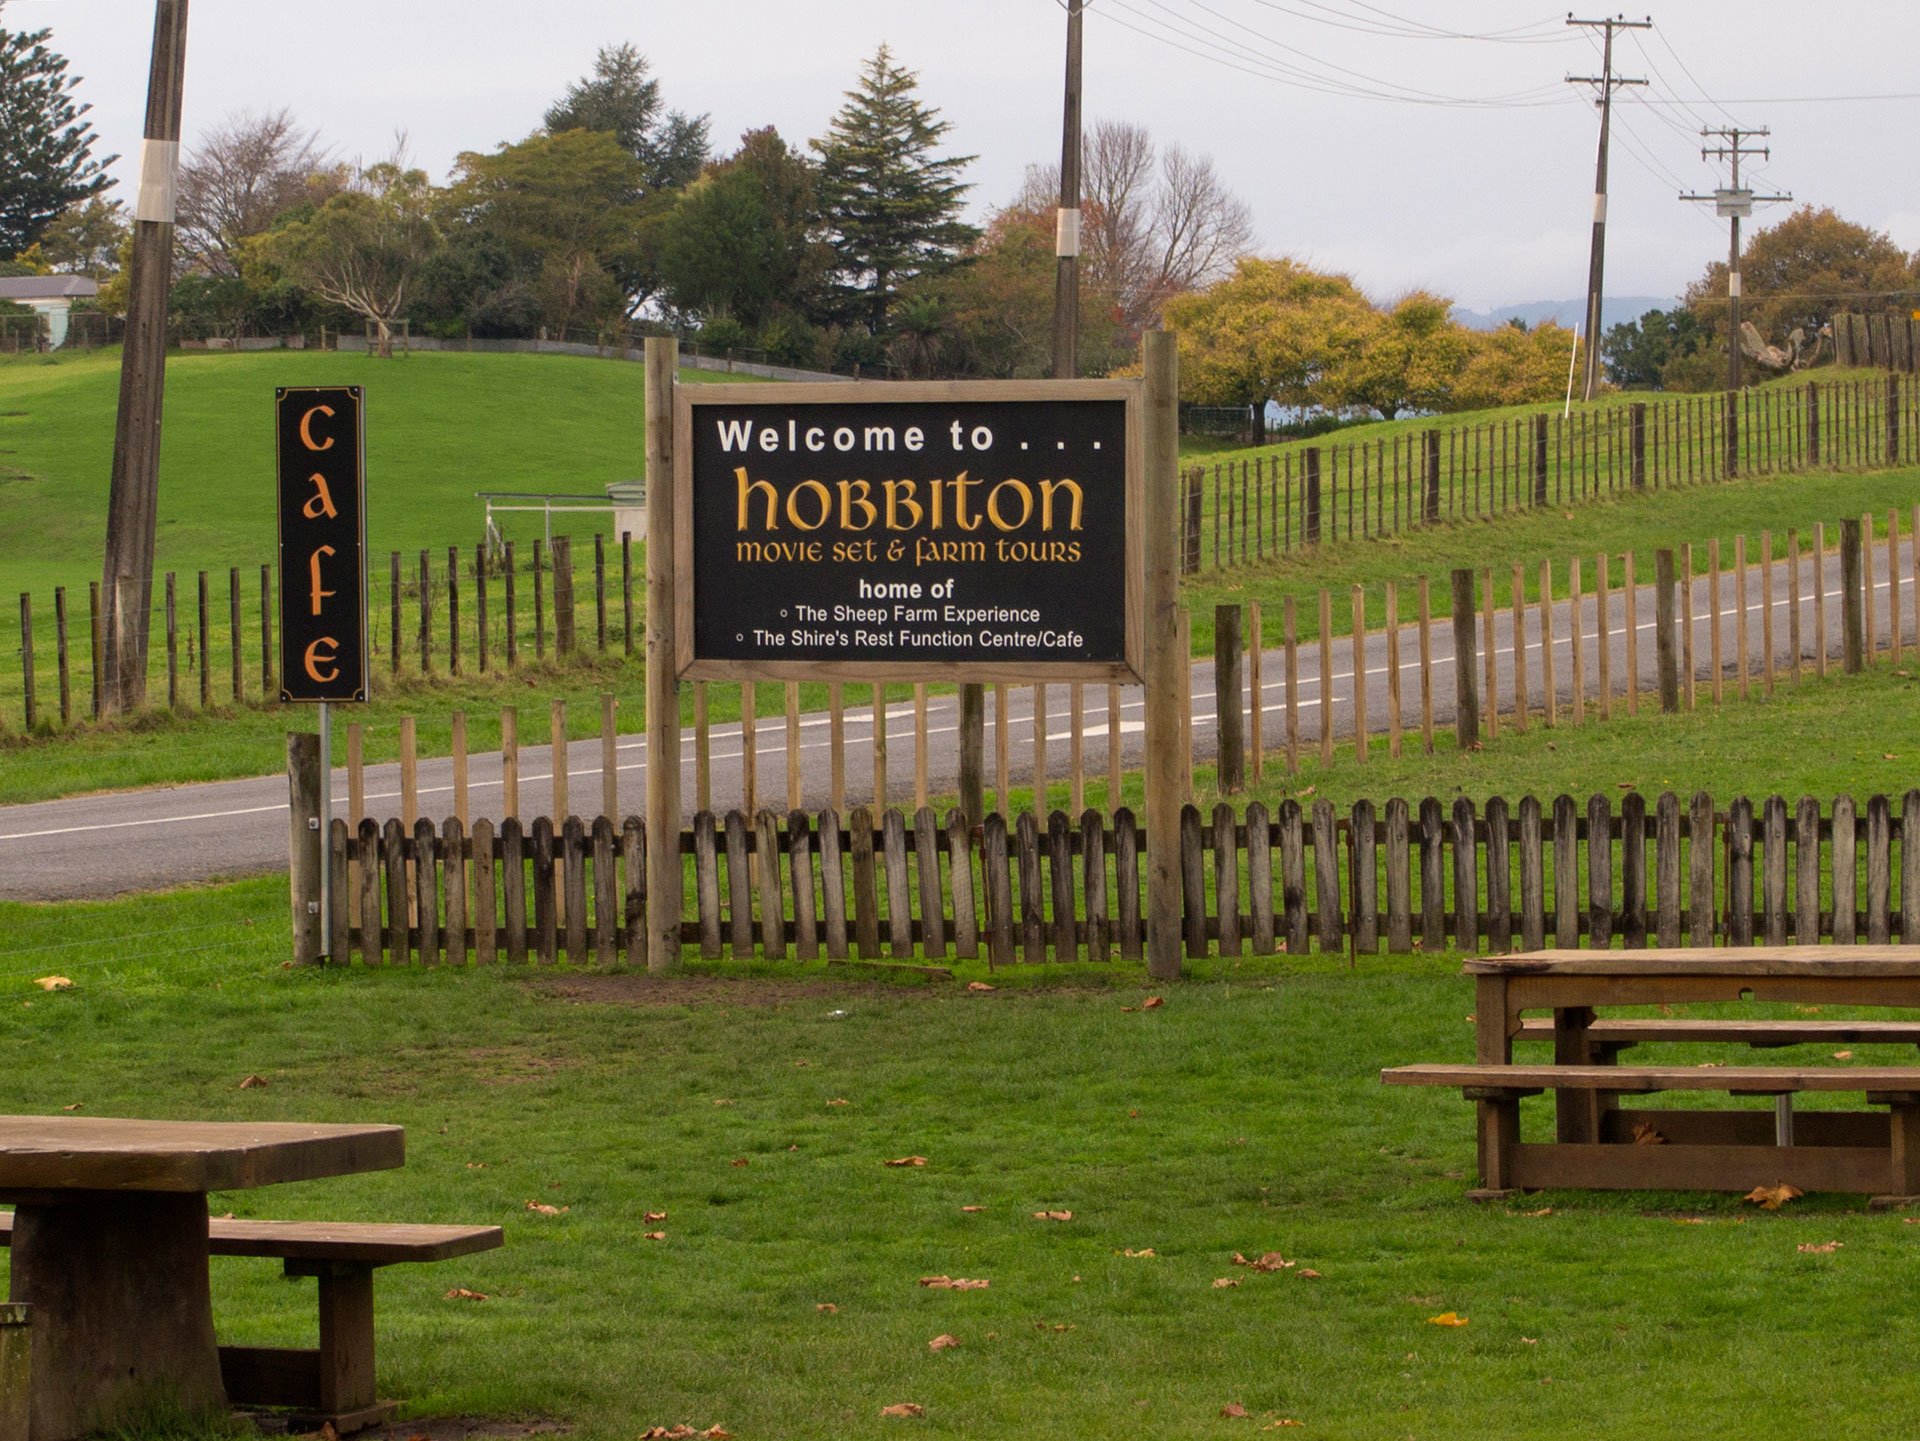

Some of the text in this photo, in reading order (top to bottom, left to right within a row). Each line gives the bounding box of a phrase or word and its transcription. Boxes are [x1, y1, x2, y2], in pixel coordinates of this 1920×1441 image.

[717, 420, 925, 452] Welcome
[950, 420, 993, 451] to
[300, 405, 340, 683] Cafe
[886, 539, 906, 562] &
[859, 579, 955, 599] home of
[796, 605, 1040, 626] The Sheep Farm Experience
[753, 630, 1084, 648] The Shire's Rest Function Centre/Cafe
